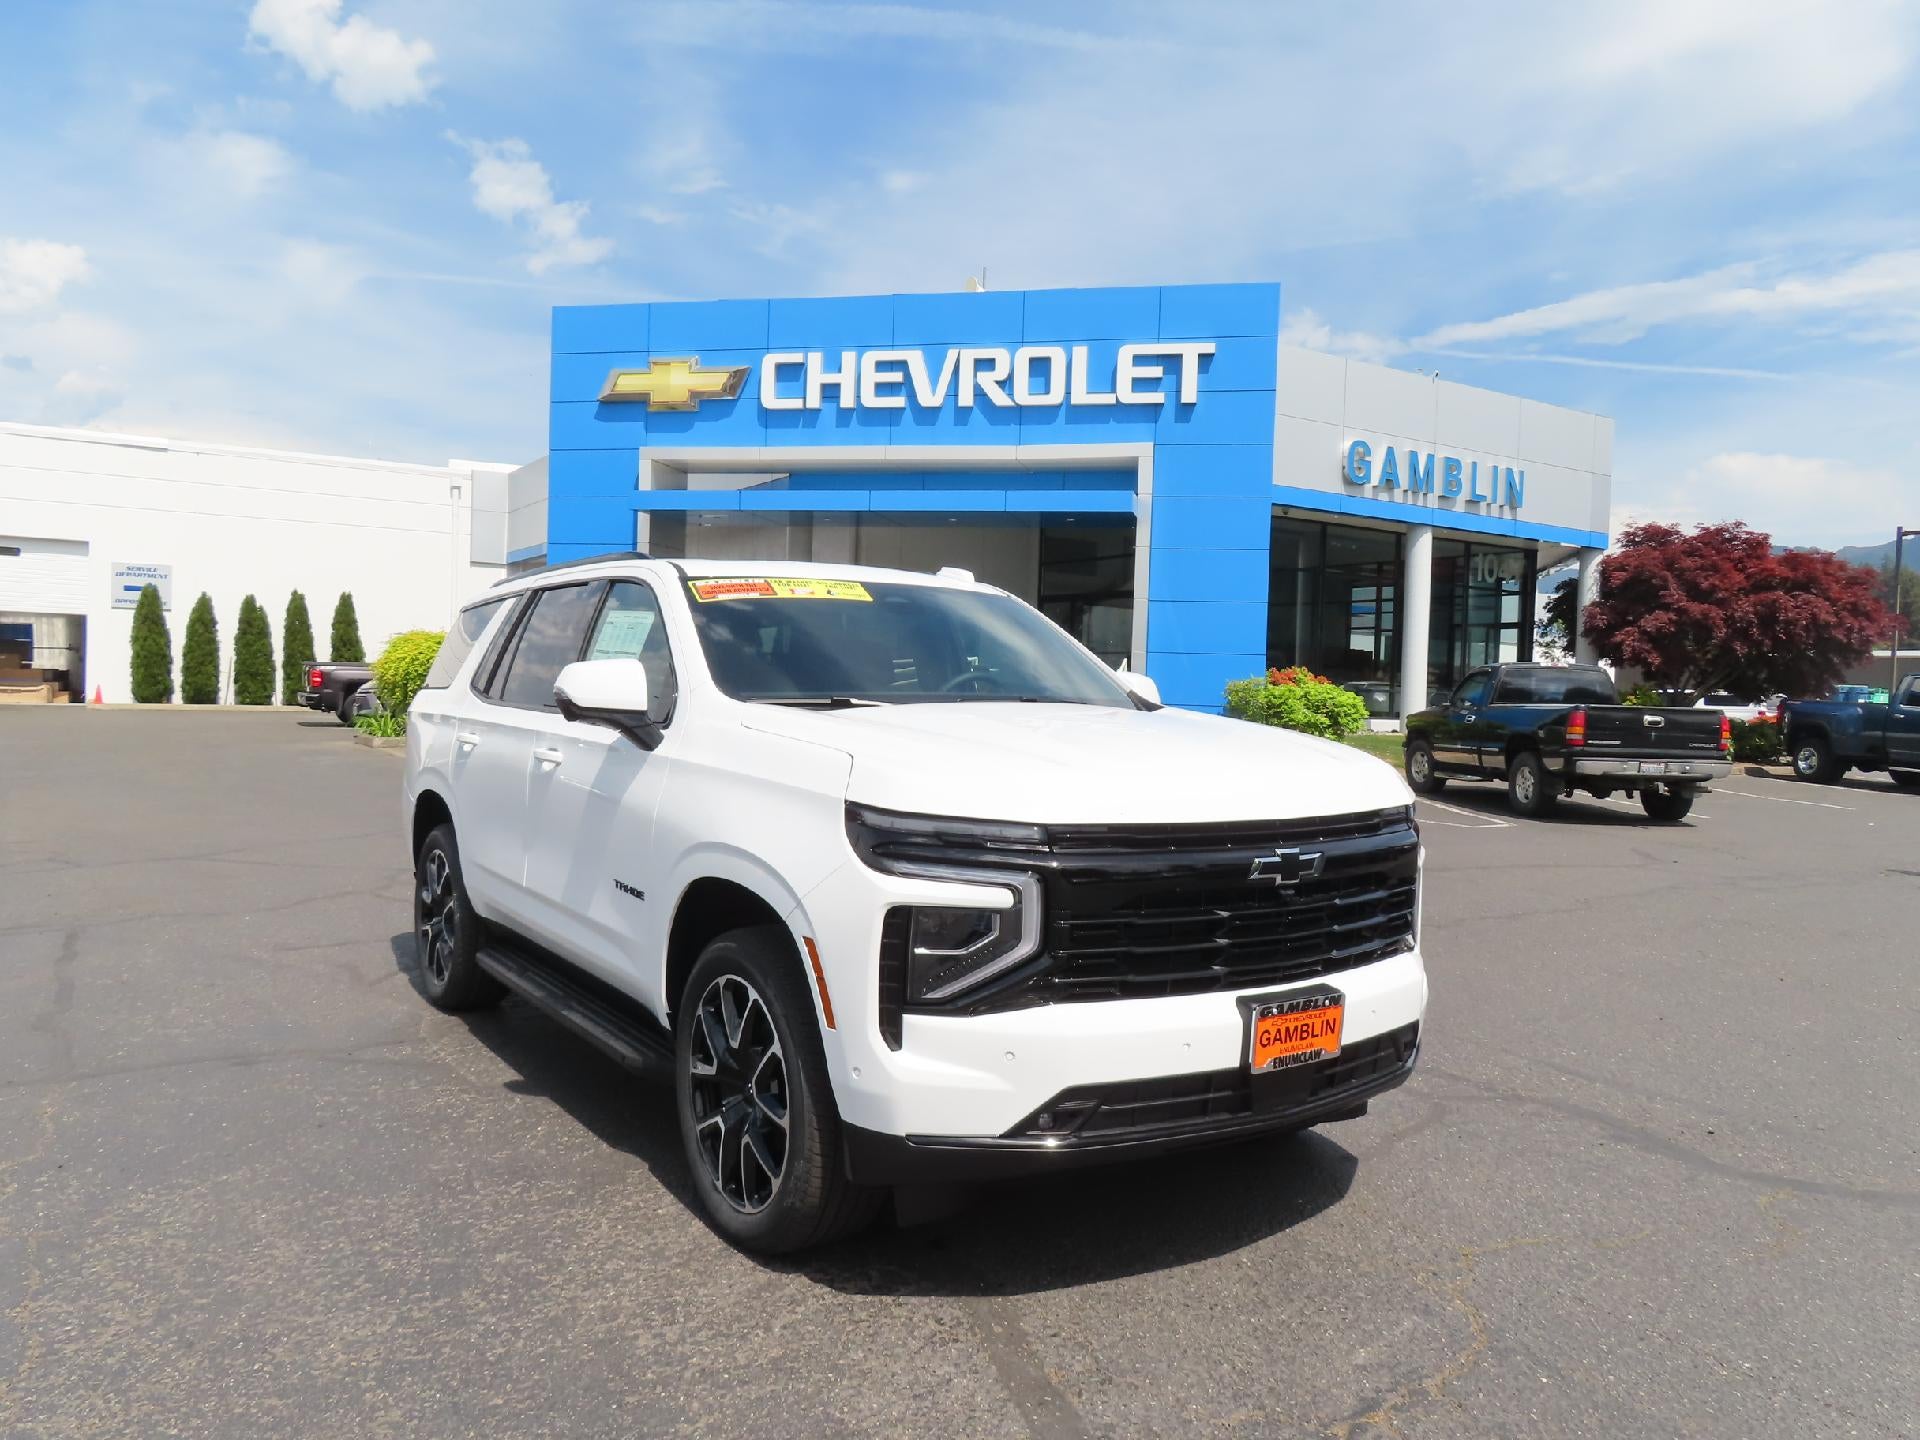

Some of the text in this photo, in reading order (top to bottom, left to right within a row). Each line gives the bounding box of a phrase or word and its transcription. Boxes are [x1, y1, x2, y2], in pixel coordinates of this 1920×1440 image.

[759, 342, 1216, 410] CHEVROLET
[1345, 439, 1525, 508] GAMBLIN
[612, 878, 645, 901] TAHOE
[1260, 995, 1341, 1018] GAMBLIN
[1260, 1018, 1336, 1048] GAMBLIN
[1273, 1048, 1322, 1069] ENUMCLAW
